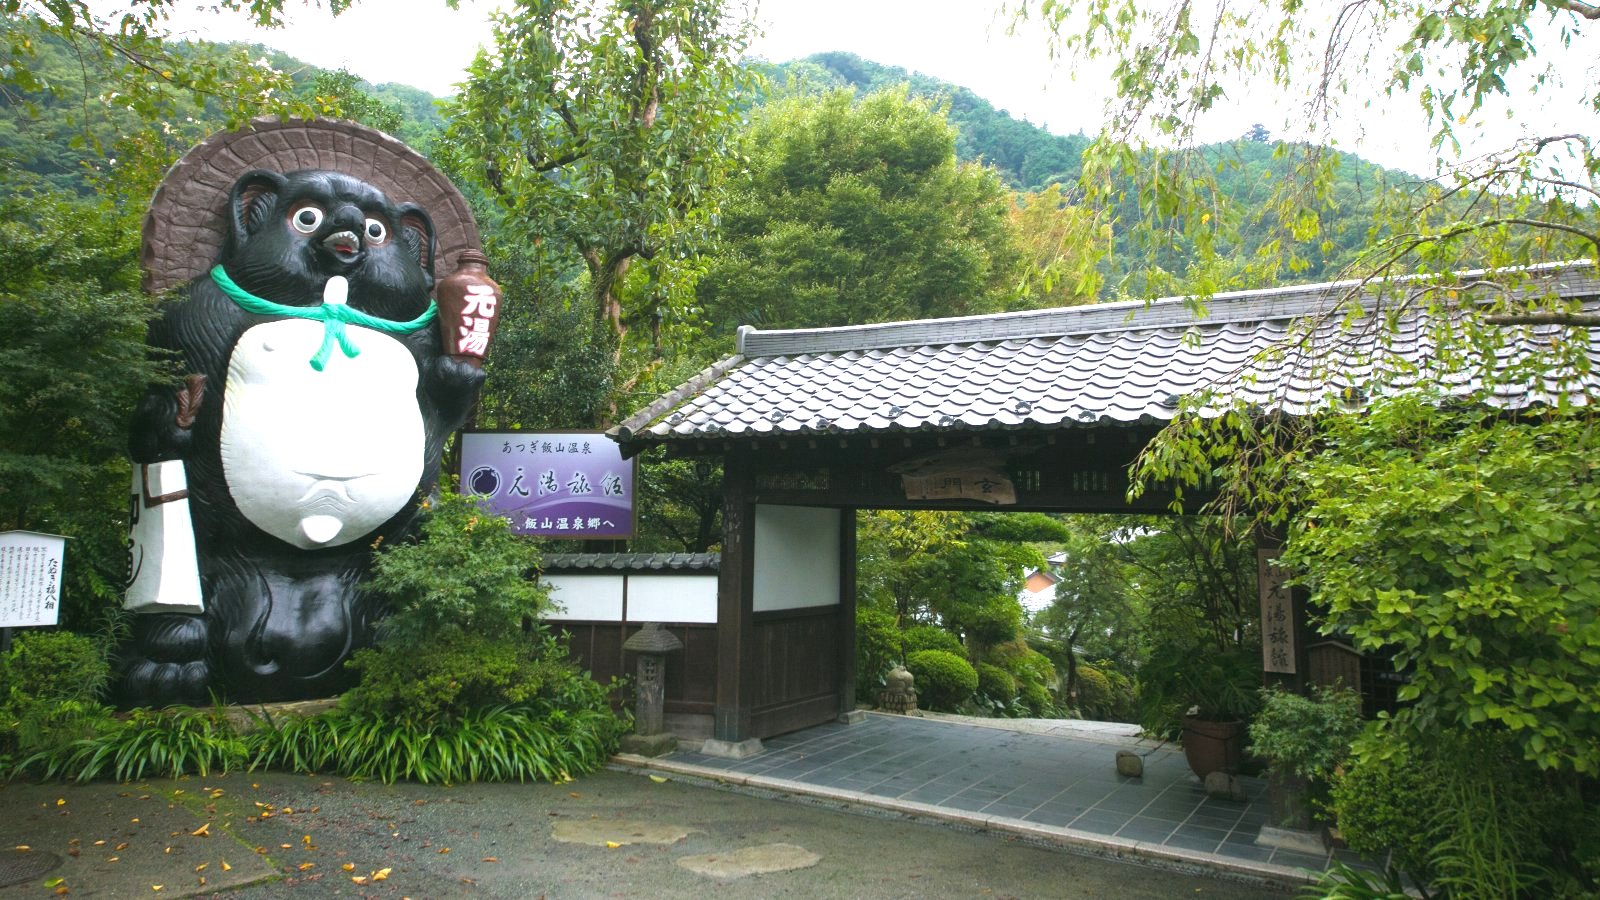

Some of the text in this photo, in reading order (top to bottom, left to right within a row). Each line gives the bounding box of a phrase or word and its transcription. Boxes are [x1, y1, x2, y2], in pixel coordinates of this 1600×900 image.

[458, 285, 497, 356] 元湯
[502, 440, 593, 455] あつぎ飯山温泉
